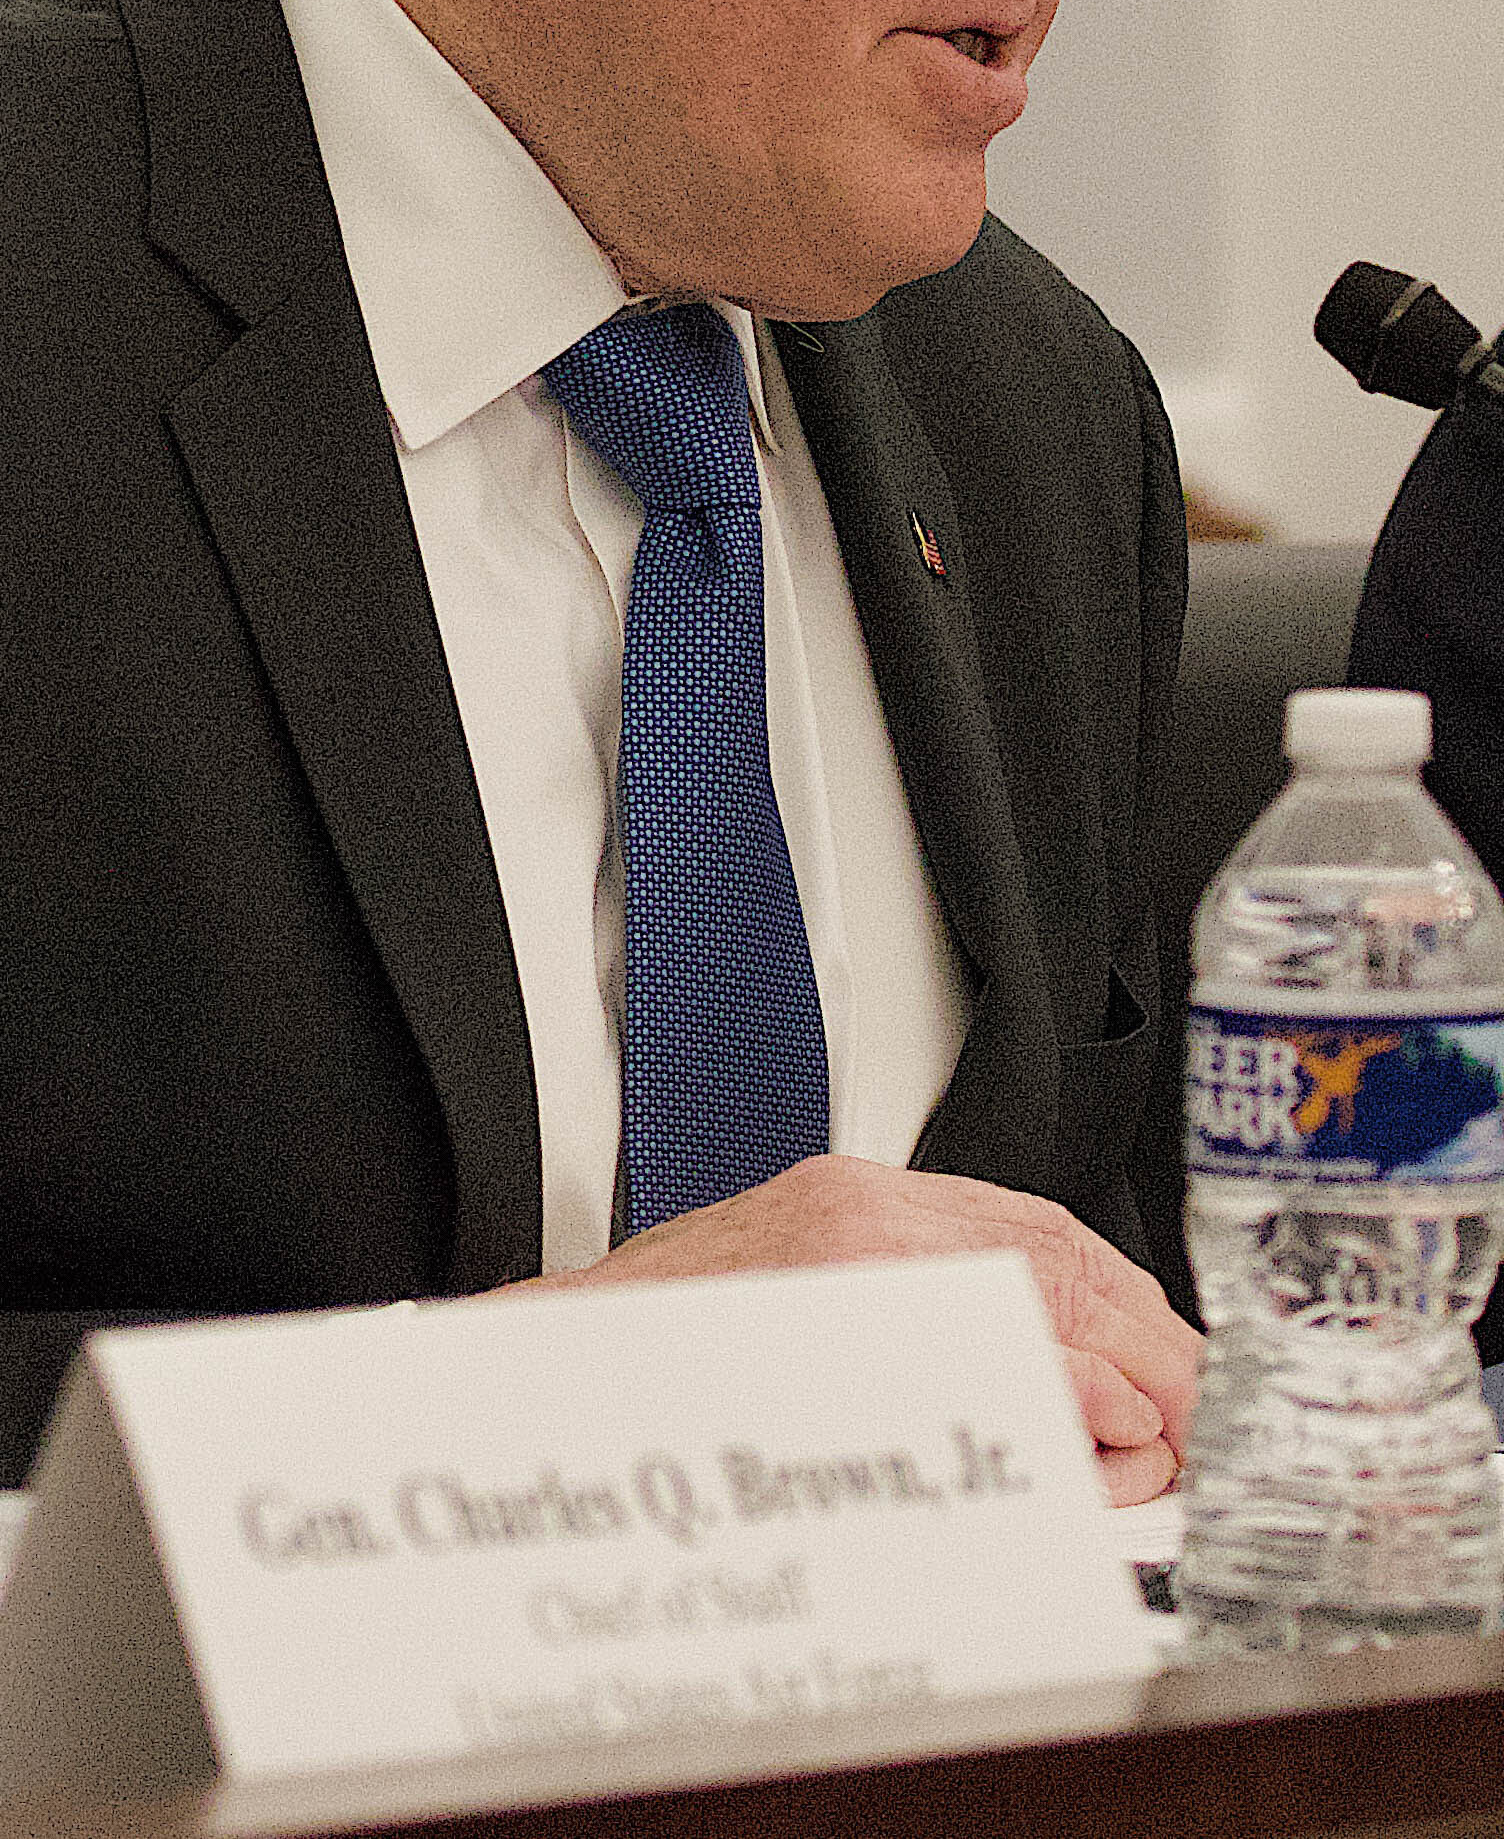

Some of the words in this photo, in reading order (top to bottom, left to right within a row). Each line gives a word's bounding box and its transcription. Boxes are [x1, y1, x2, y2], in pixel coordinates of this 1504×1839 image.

[239, 1482, 392, 1568] Gen.
[394, 1462, 629, 1555] Charles
[633, 1448, 720, 1548] Q.
[720, 1443, 945, 1526] Brown,
[950, 1420, 1034, 1500] Jr.
[525, 1570, 644, 1648] Chief
